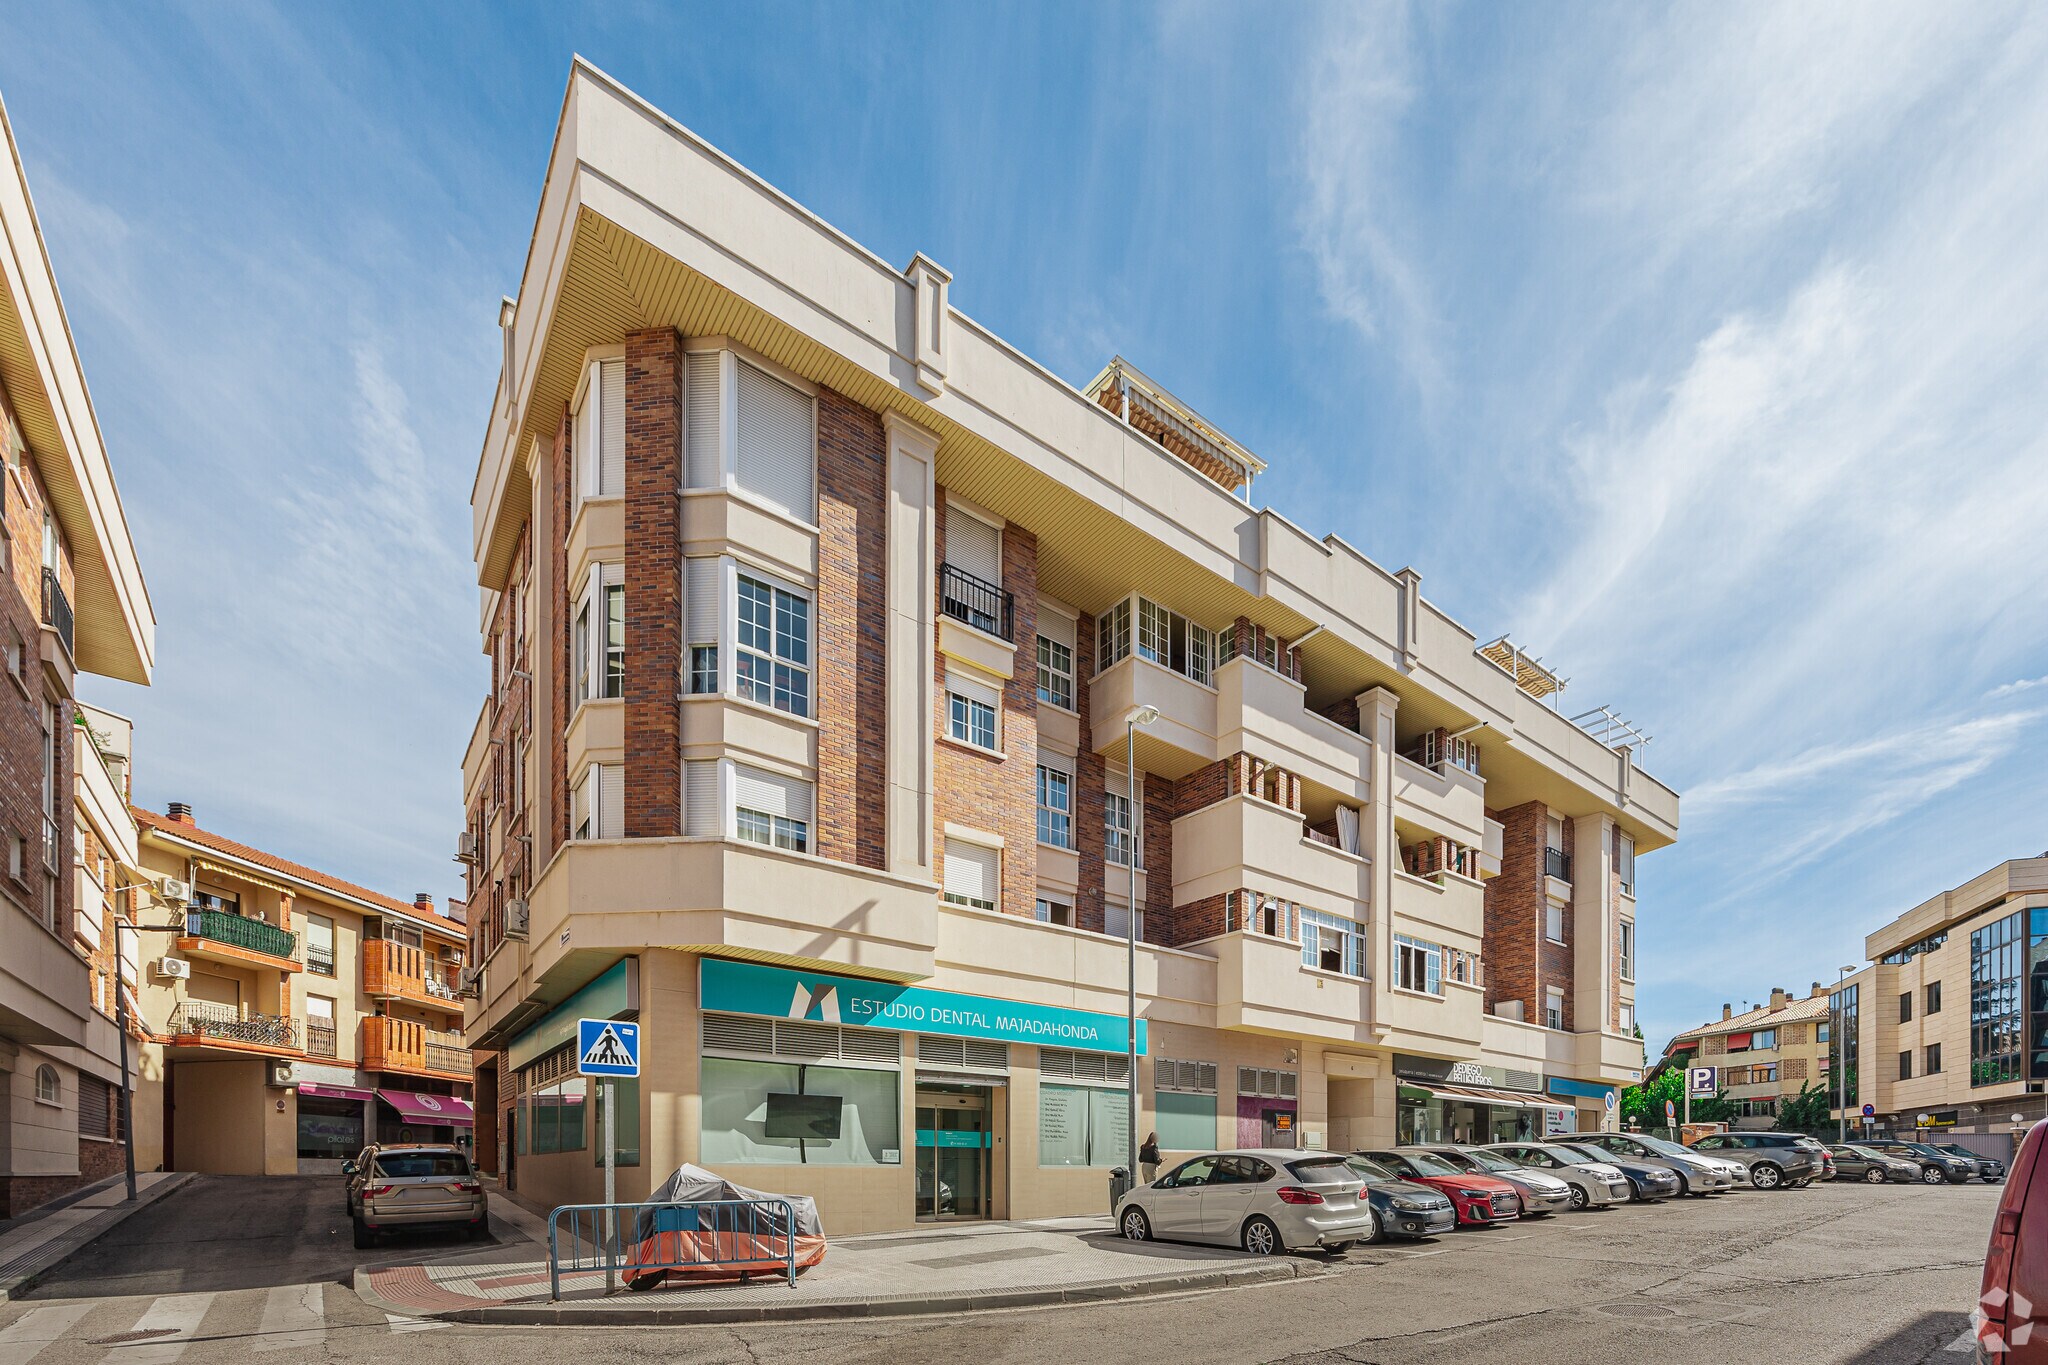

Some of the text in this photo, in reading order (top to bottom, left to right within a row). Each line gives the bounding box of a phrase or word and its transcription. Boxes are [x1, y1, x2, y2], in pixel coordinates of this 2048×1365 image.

[851, 997, 1099, 1041] ESTUDIO DENTAL MAJADAHONDA
[1693, 1069, 1711, 1088] P
[327, 1135, 355, 1144] pilates
